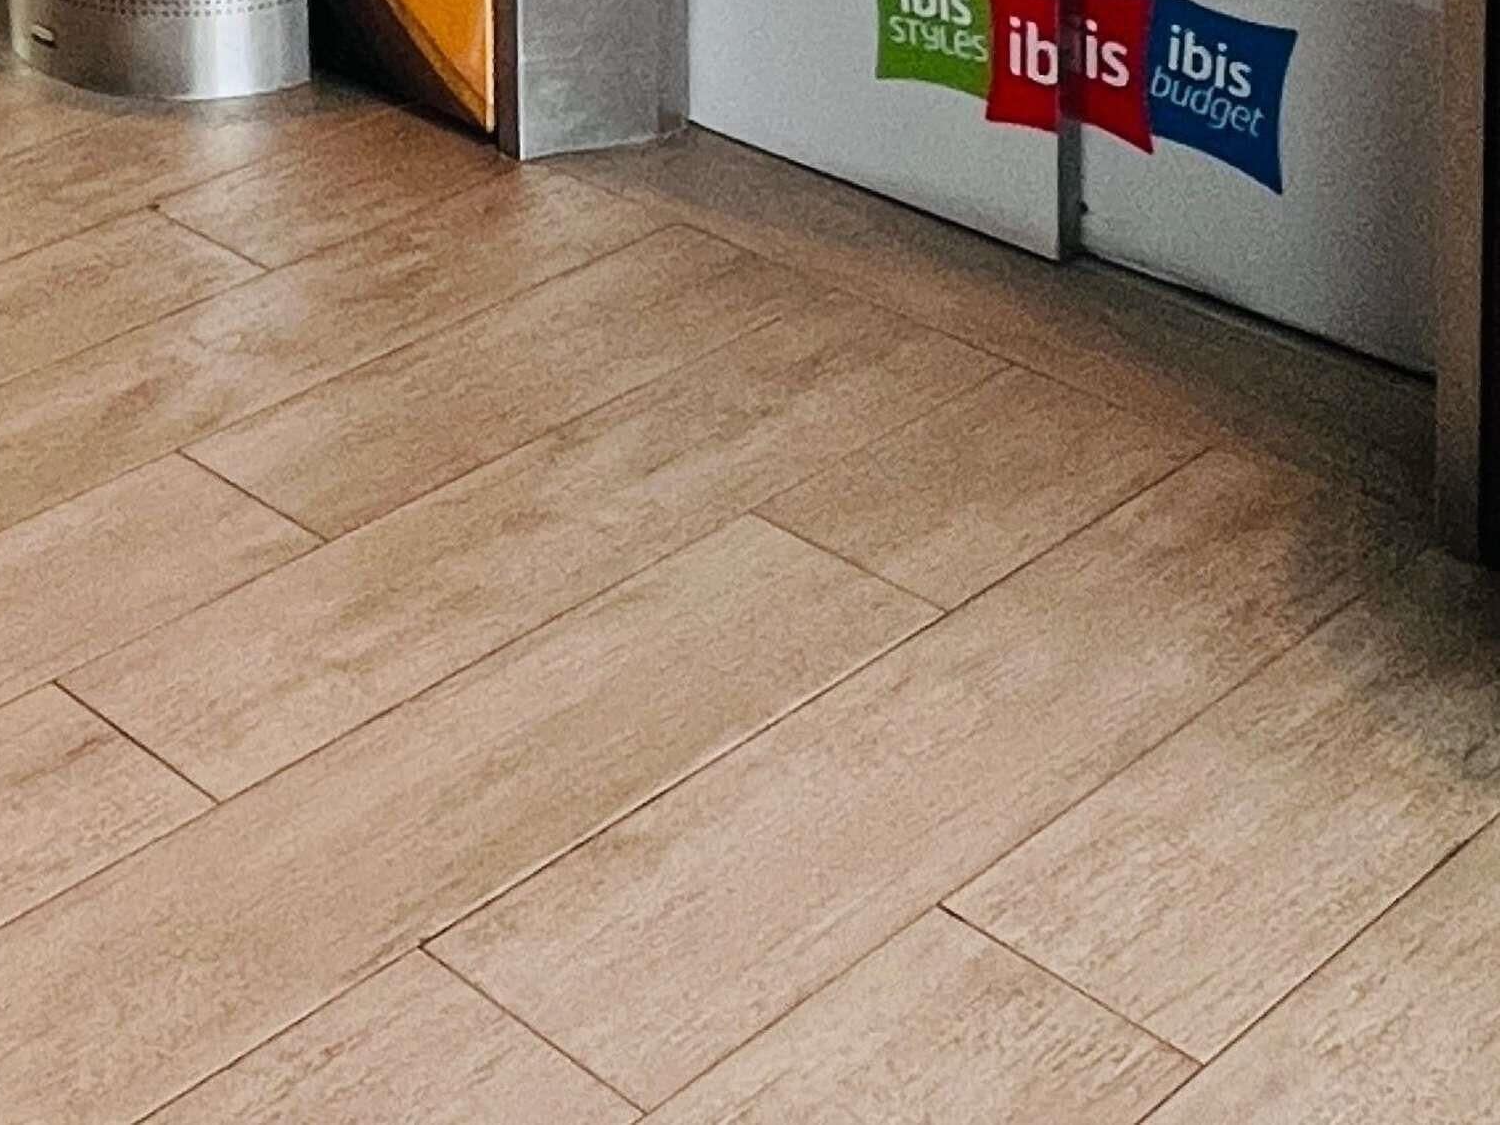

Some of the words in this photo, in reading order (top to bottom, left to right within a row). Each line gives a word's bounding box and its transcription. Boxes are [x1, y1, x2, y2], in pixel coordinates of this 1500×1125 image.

[1008, 16, 1130, 87] ibis
[1167, 24, 1252, 98] ibis
[1150, 66, 1265, 138] budget
